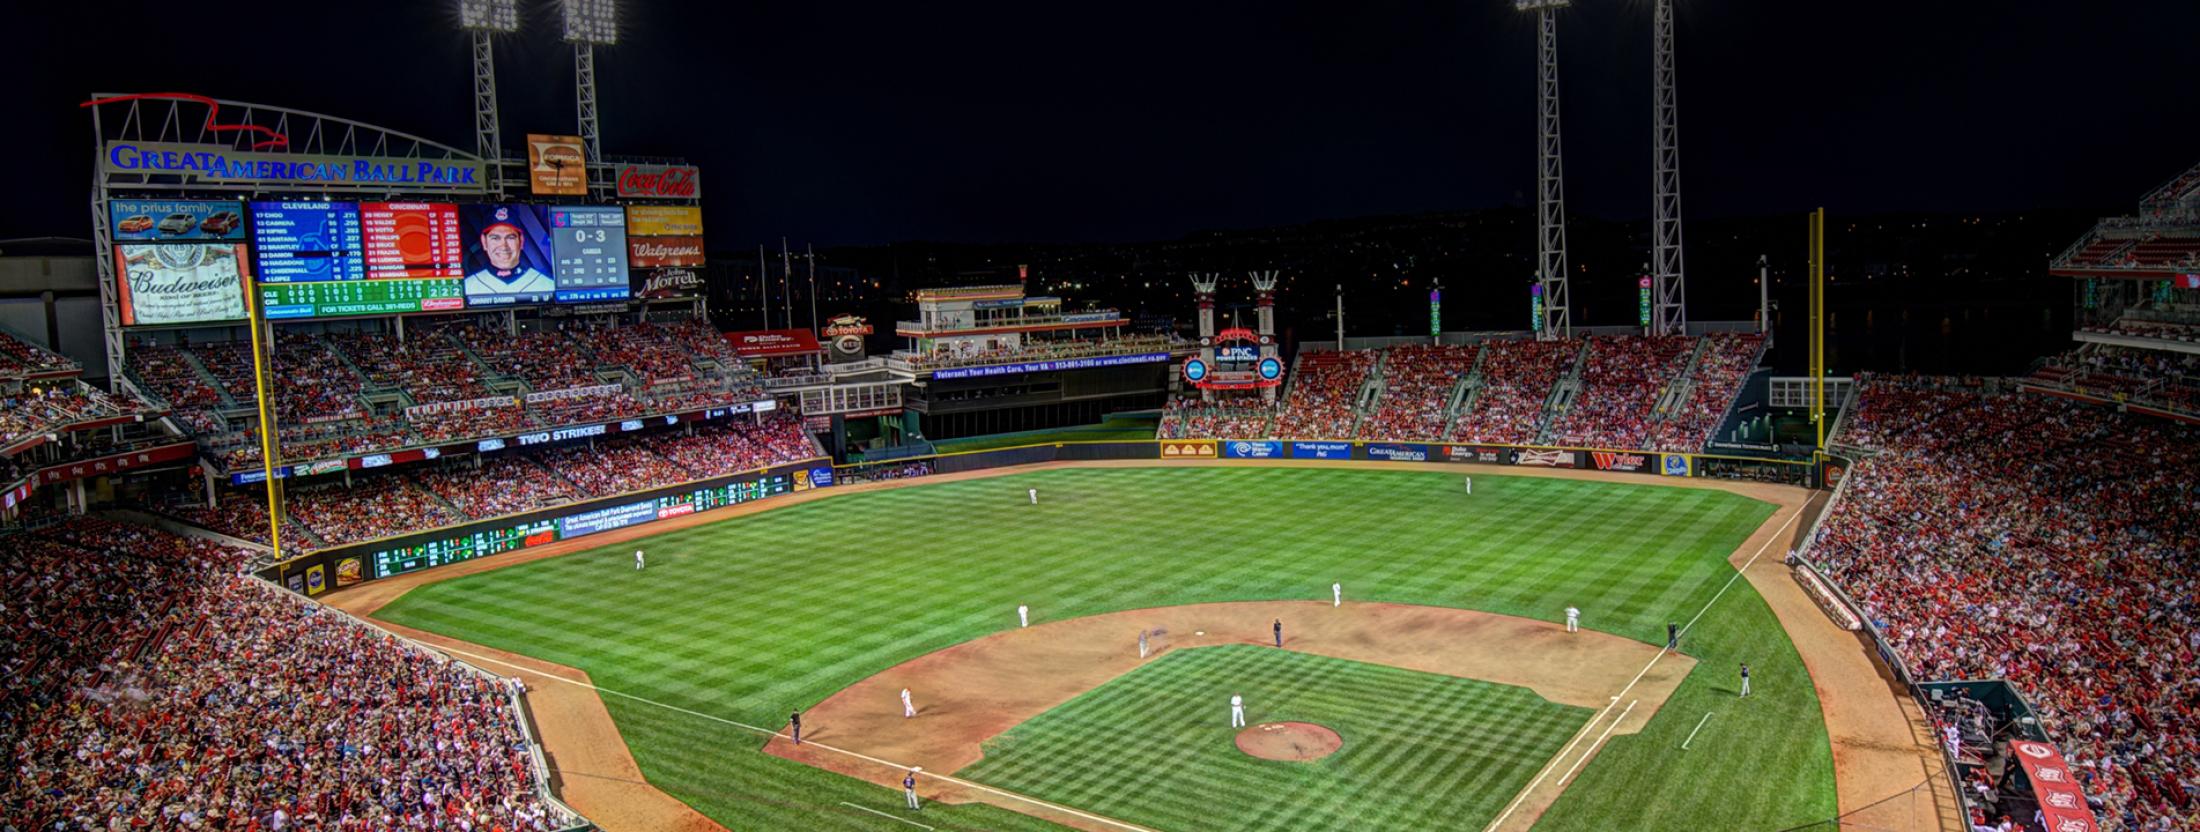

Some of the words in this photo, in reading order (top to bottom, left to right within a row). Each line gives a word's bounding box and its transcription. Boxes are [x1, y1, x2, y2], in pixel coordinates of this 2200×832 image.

[110, 144, 221, 170] GREAT
[206, 155, 350, 181] AMERICAN
[353, 161, 414, 182] BALL
[416, 162, 477, 185] PARK
[116, 202, 137, 213] the
[141, 202, 172, 215] prius
[175, 202, 214, 214] family
[576, 230, 586, 242] 0
[596, 230, 606, 242] 3
[632, 243, 701, 260] Walgreens
[129, 270, 239, 294] Budweiser
[634, 272, 705, 297] Morrell
[430, 288, 438, 297] 2
[441, 288, 448, 297] 2
[452, 288, 460, 296] 2
[470, 297, 492, 305] JOHNNY
[494, 296, 516, 304] DAMON
[338, 304, 366, 312] TICKETS
[838, 326, 868, 336] TOYOTA
[1231, 348, 1252, 356] PNC
[936, 370, 968, 380] Veterans!
[969, 368, 984, 376] Your
[984, 366, 1006, 375] Health
[1007, 366, 1024, 374] Care,
[1025, 364, 1039, 372] Your
[519, 432, 550, 446] TWO
[552, 425, 606, 443] STRIKES!
[1370, 447, 1392, 455] GREAT
[1391, 449, 1425, 457] AMERICAN
[1592, 452, 1645, 470] Wyler
[578, 512, 600, 520] American
[669, 505, 692, 515] TOYOTA
